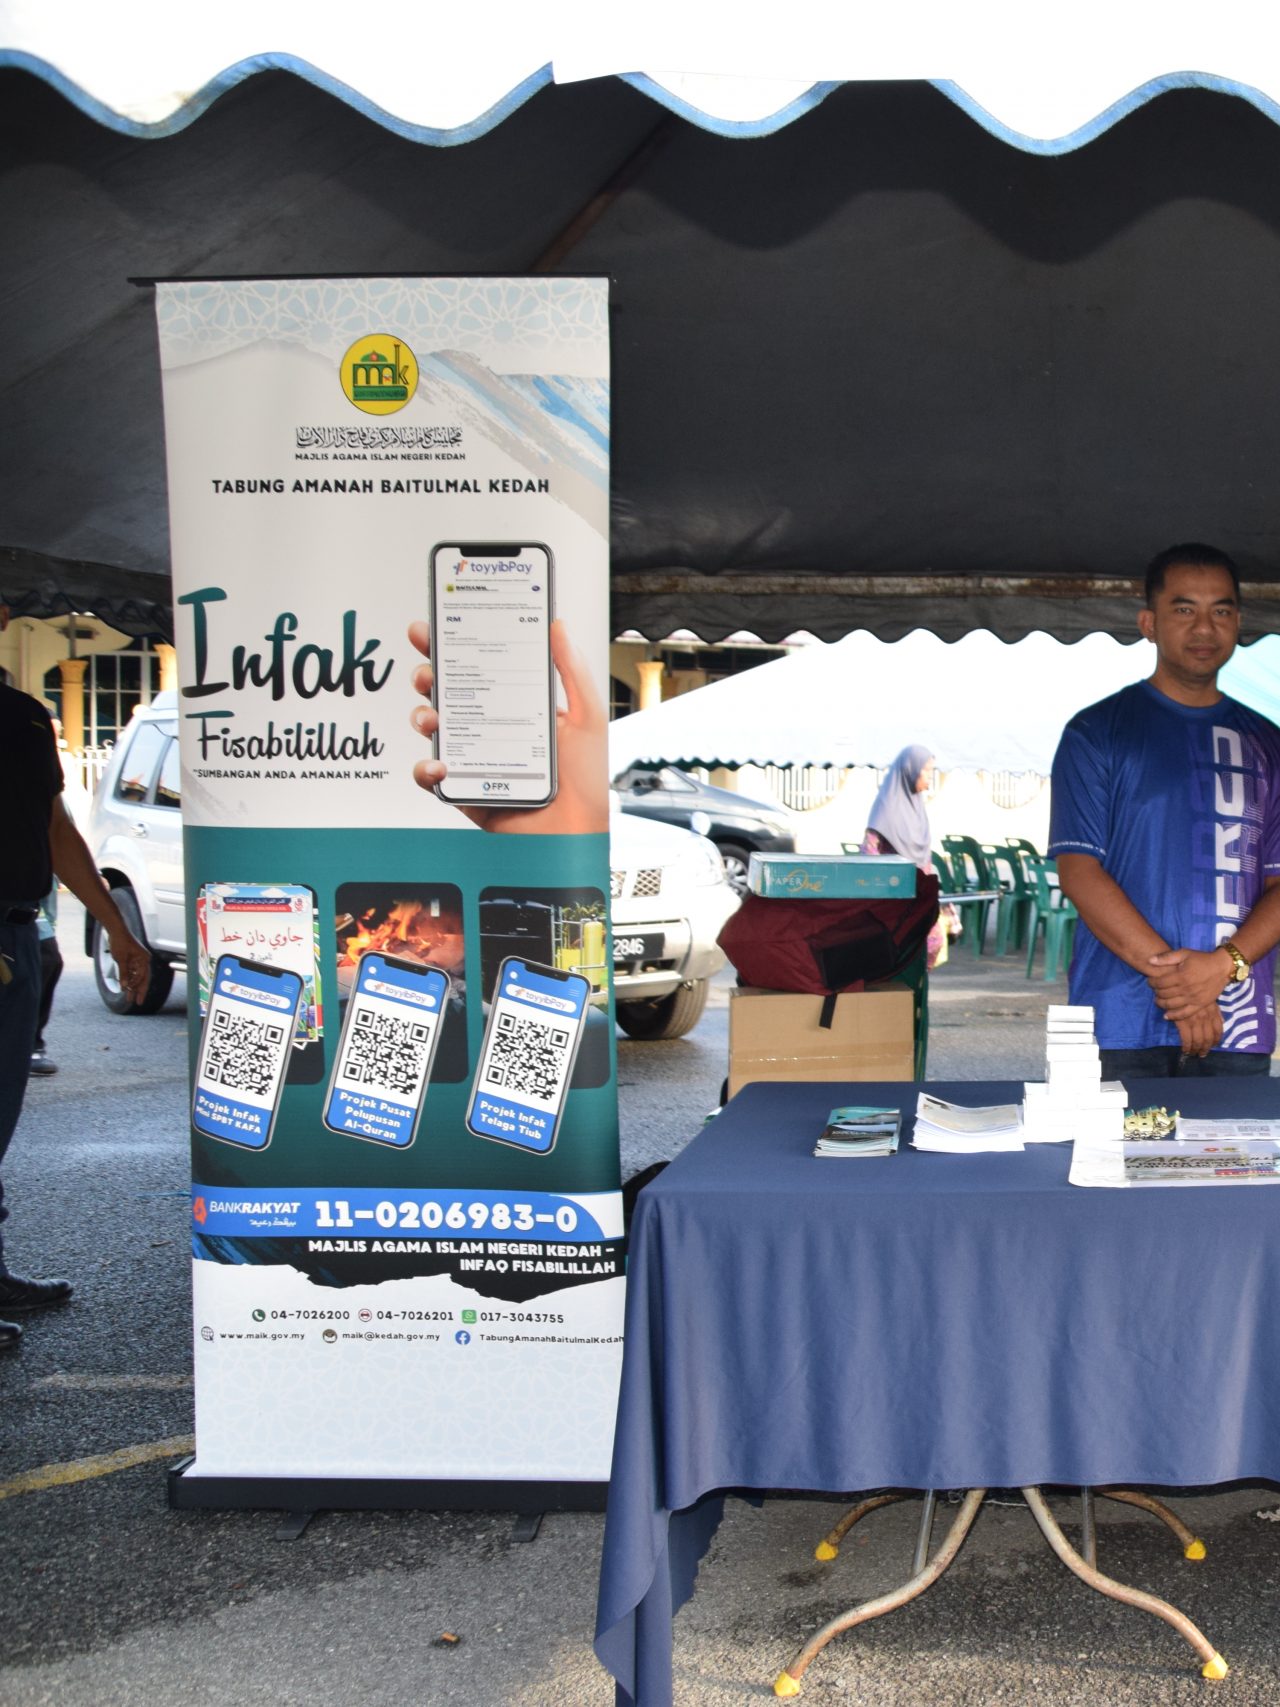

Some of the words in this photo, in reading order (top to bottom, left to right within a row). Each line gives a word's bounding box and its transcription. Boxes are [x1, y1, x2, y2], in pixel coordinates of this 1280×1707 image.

[212, 478, 285, 494] TABUNG
[292, 478, 373, 494] AMANAH
[381, 478, 481, 494] BAITULMAL
[489, 478, 549, 493] KEDAH
[470, 560, 533, 575] toyyibPay
[178, 587, 394, 701] Infak
[185, 710, 385, 761] Fisabilillah
[264, 770, 296, 779] ANDA
[300, 770, 351, 779] AMANAH
[492, 783, 510, 791] FPX
[221, 926, 242, 942] خط
[246, 929, 265, 946] دان
[269, 927, 304, 950] جاوي
[240, 987, 281, 1005] toyyibPay
[385, 986, 426, 1003] toyyibPay
[526, 991, 567, 1010] toyyibPay
[199, 1095, 230, 1115] Projek
[233, 1108, 261, 1123] Infak
[340, 1092, 377, 1109] Projek
[380, 1102, 411, 1118] Pusat
[345, 1106, 400, 1128] Pelupusan
[480, 1100, 516, 1118] Projek
[518, 1112, 546, 1128] Infak
[211, 1112, 234, 1125] SPBT
[235, 1120, 261, 1134] KAFA
[344, 1119, 397, 1140] Al-Quran
[480, 1113, 516, 1132] Telaga
[519, 1126, 542, 1140] Tiub
[209, 1201, 301, 1214] BANKRAKYAT
[315, 1199, 577, 1233] 11-0206983-0
[308, 1240, 366, 1253] MAJLIS
[371, 1240, 432, 1254] AGAMA
[436, 1241, 484, 1254] ISLAM
[488, 1242, 543, 1256] NEGERI
[546, 1244, 601, 1257] KEDAH
[460, 1259, 508, 1273] INFAQ
[513, 1259, 616, 1274] FISABILILLAH
[271, 1310, 350, 1320] 04-7026200
[376, 1311, 454, 1321] 04-7026201
[480, 1312, 564, 1324] 017-3043755
[342, 1332, 440, 1342] maik@kedah.gov.my
